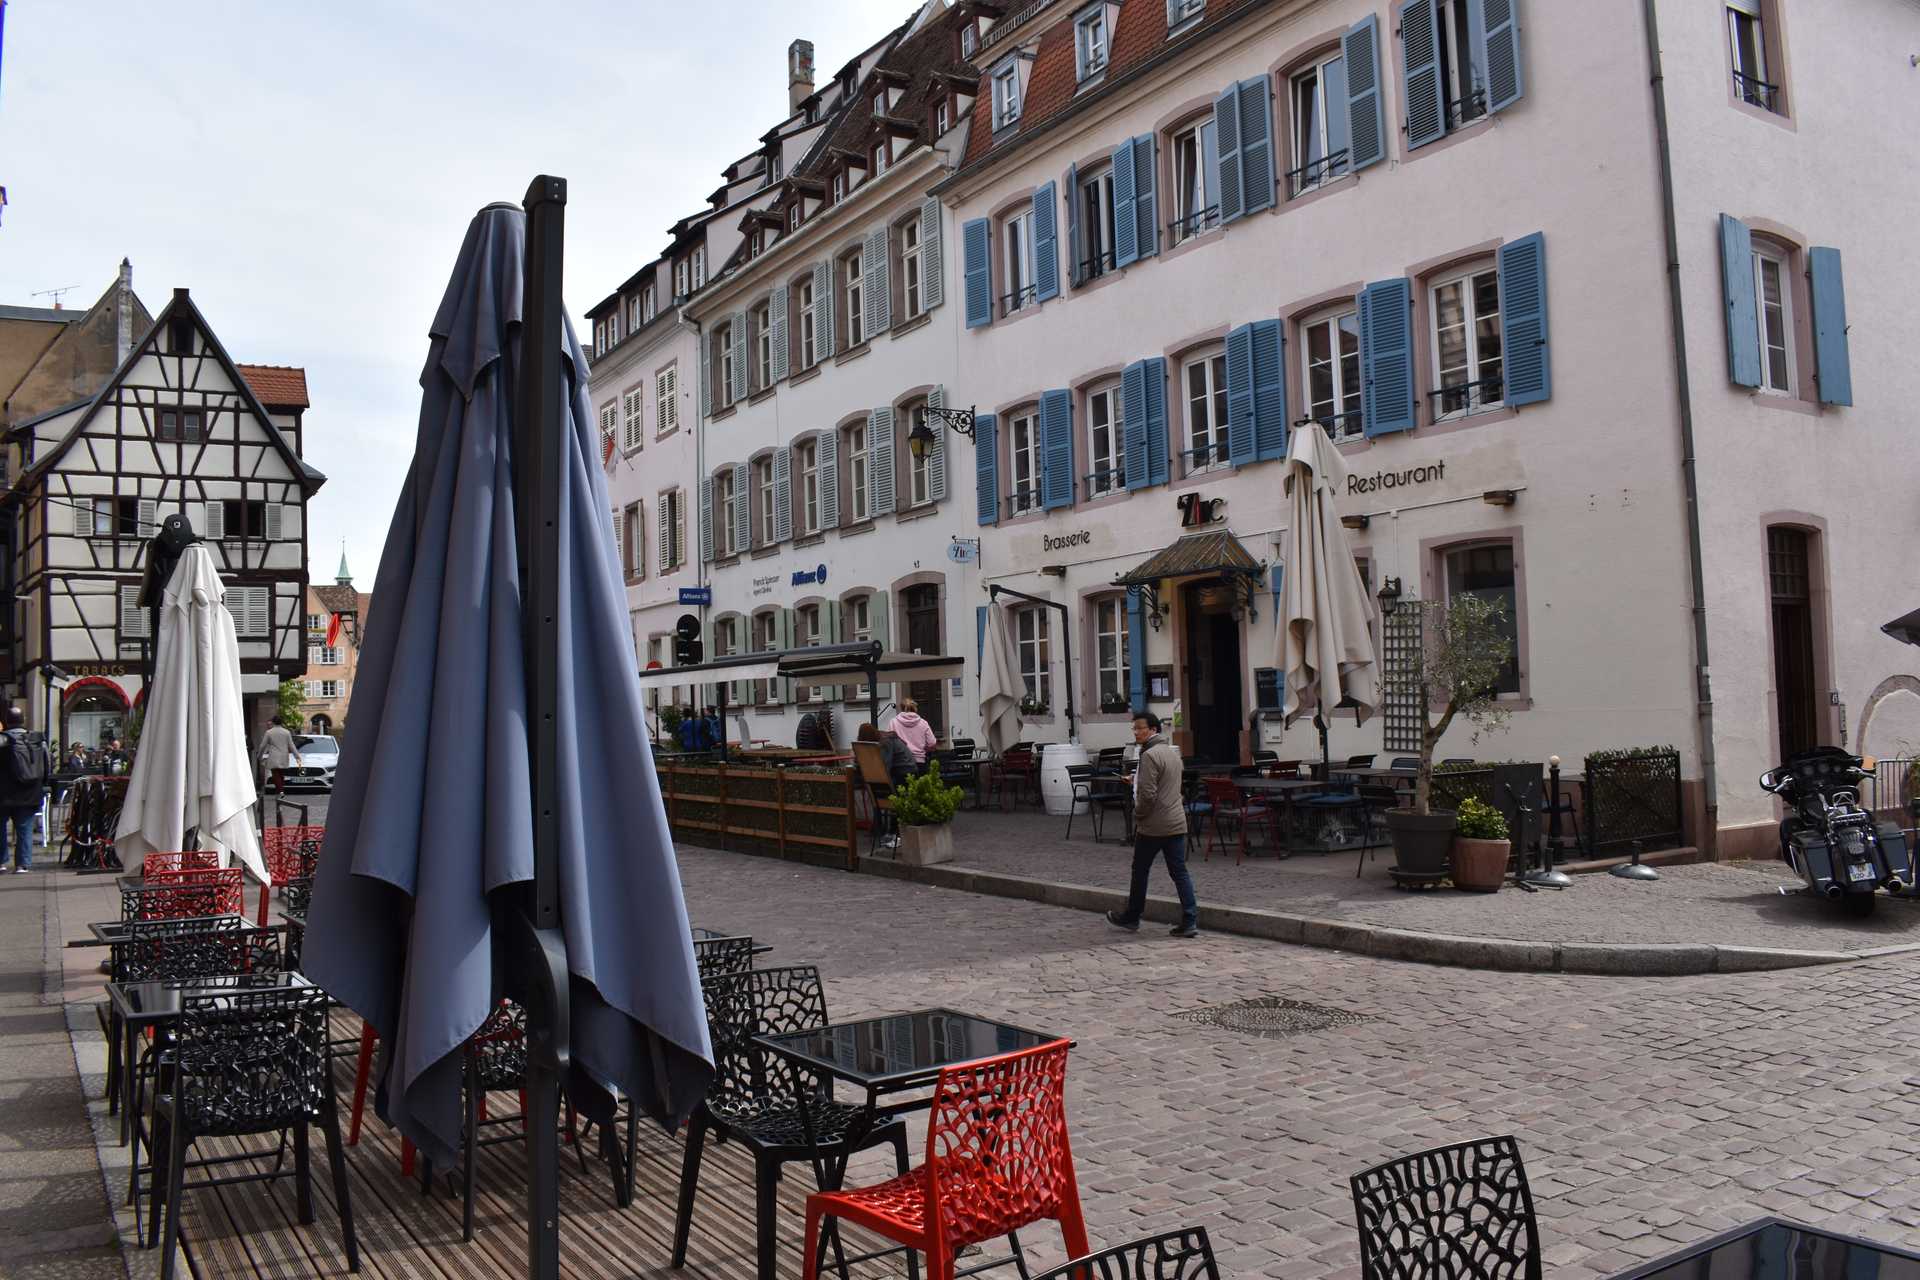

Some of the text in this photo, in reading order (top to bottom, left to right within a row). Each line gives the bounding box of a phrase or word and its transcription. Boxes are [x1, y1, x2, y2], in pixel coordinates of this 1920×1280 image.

[1347, 459, 1445, 496] Restaurant
[1043, 529, 1091, 552] Brasserie
[791, 570, 817, 587] Allianz
[682, 592, 702, 600] Allianz
